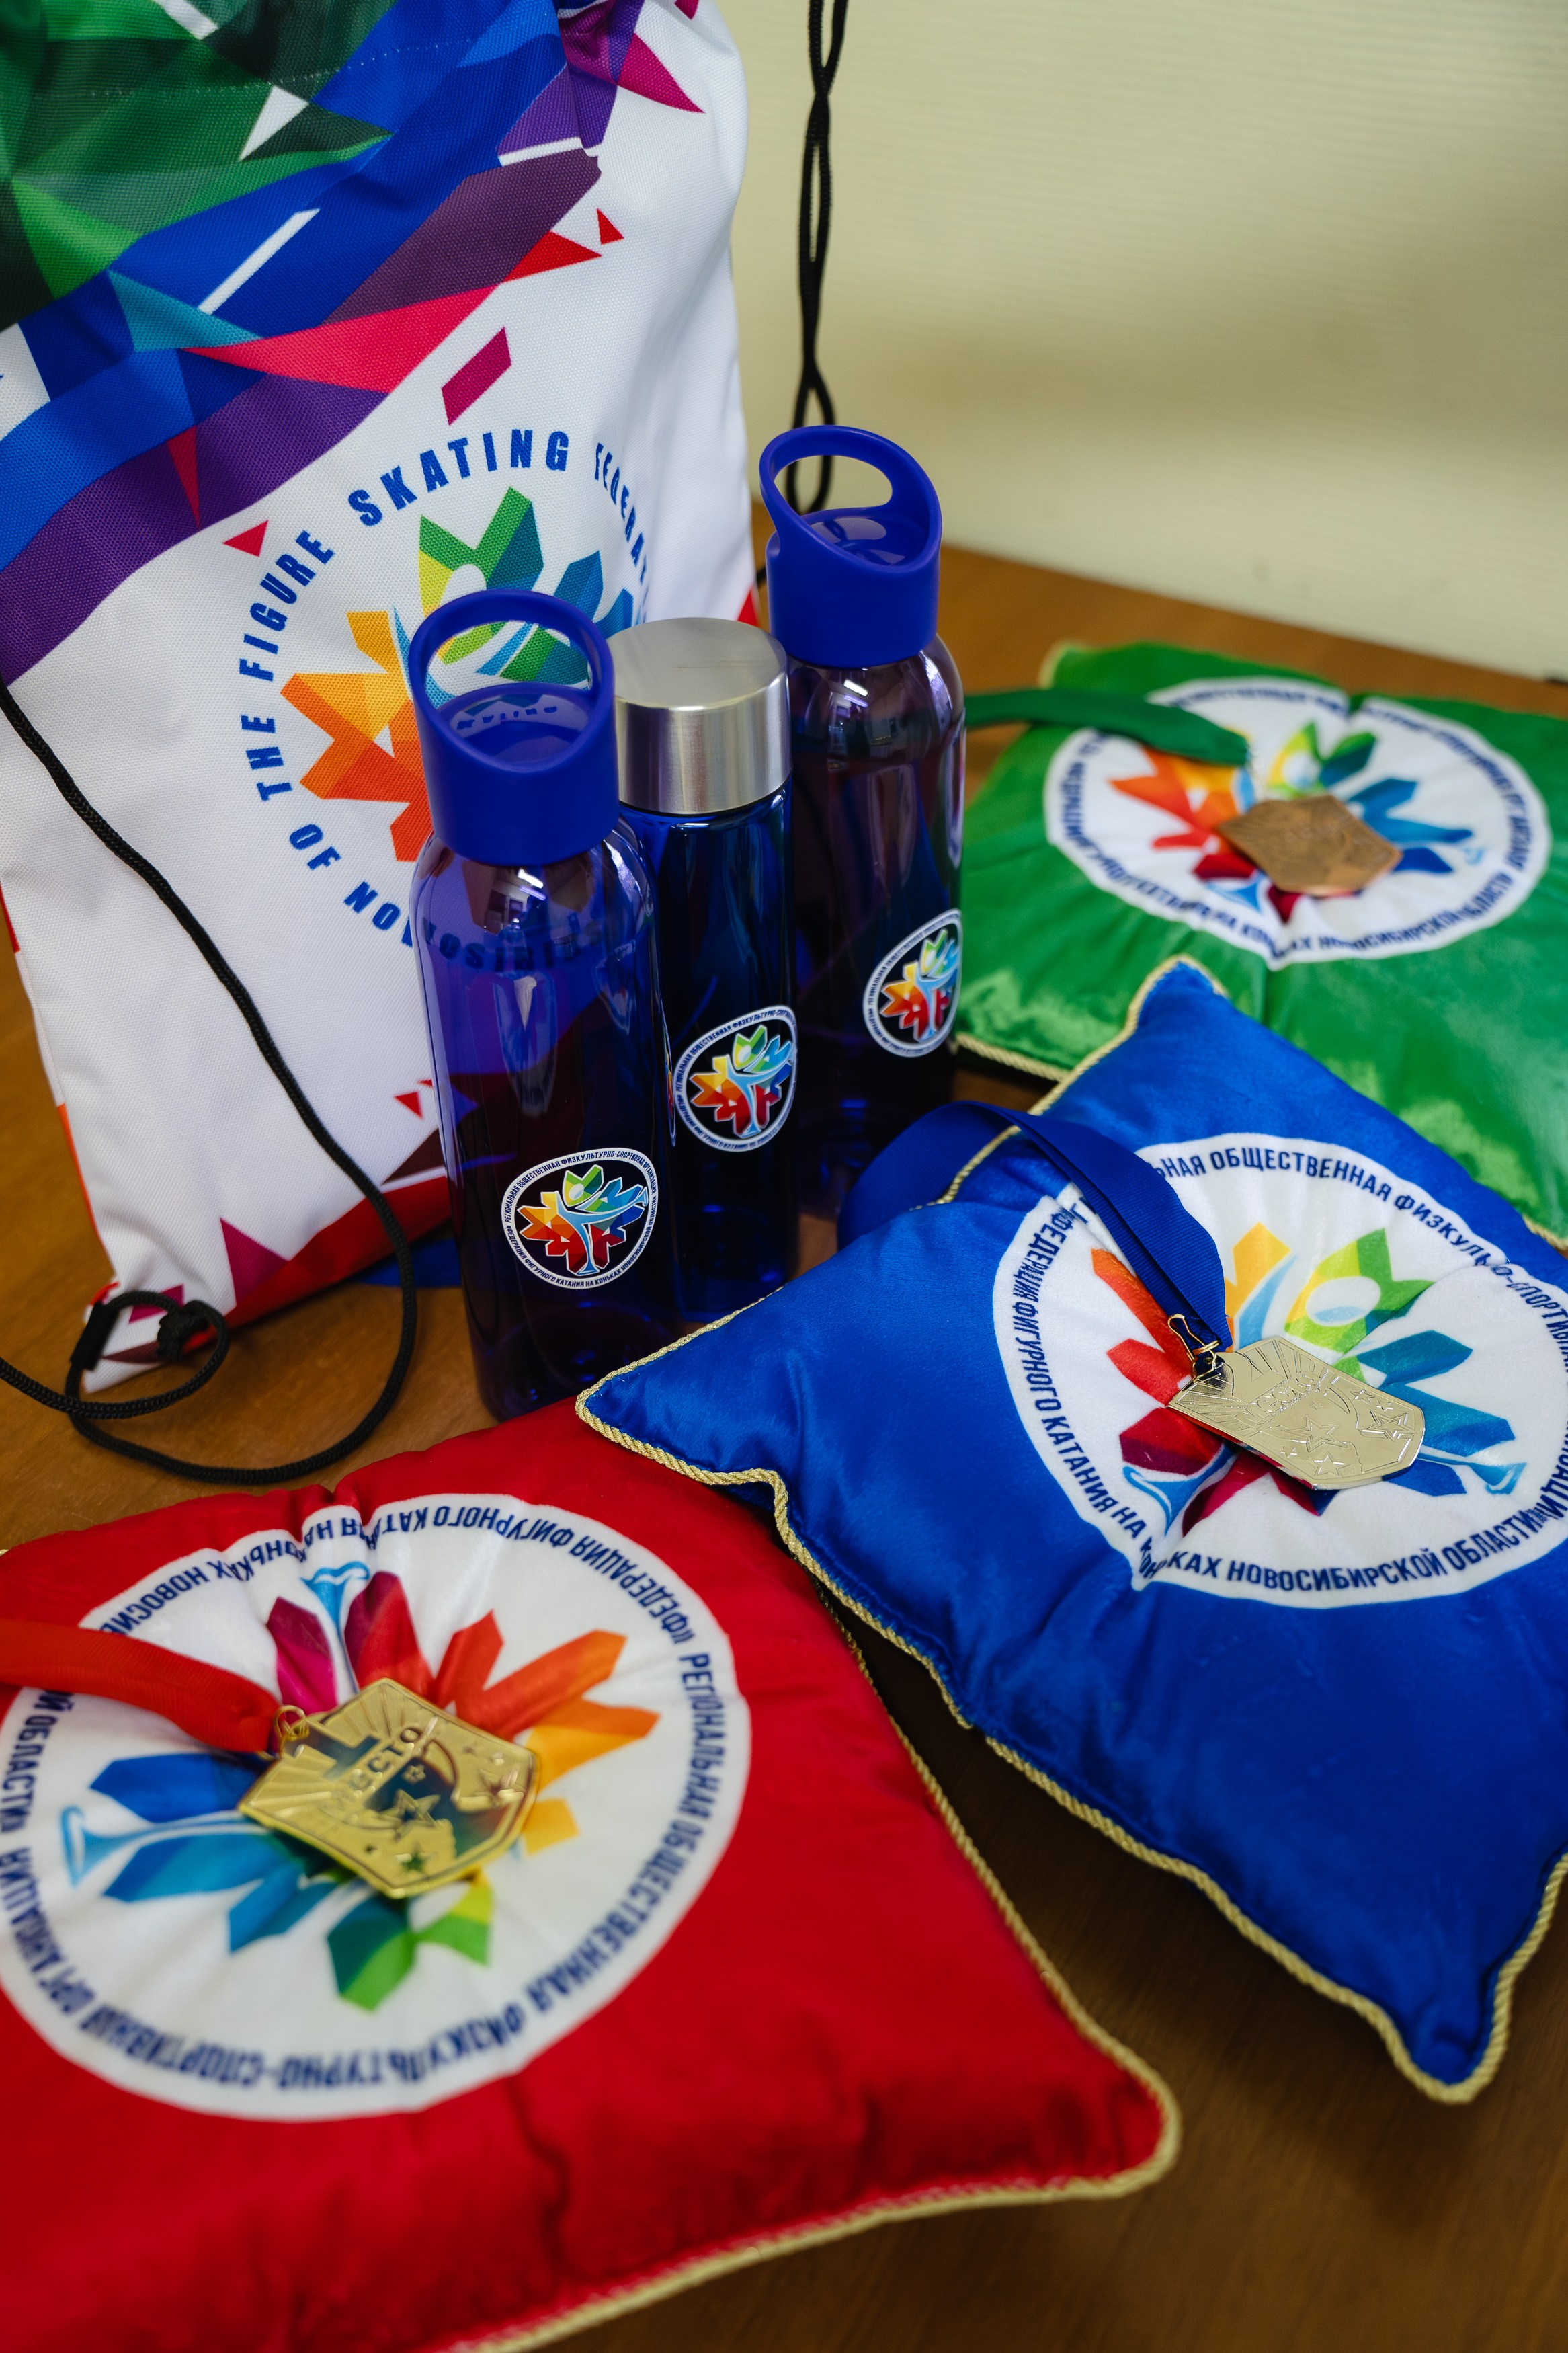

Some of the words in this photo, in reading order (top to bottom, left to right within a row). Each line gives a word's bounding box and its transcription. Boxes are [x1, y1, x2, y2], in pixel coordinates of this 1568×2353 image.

[347, 428, 570, 527] SKATING
[239, 530, 335, 682] FIGURE
[241, 714, 293, 801] THE
[288, 823, 343, 871] OF
[504, 1183, 521, 1224] РЕГИОНАЛЬНАЯ
[516, 1160, 561, 1189] ОБЩЕСТВЕННАЯ
[561, 1150, 645, 1166] ФИЗКУЛЬТУРНО-СПОРТИВНАЯ
[1210, 1146, 1392, 1203] ОБЩЕСТВЕННАЯ
[524, 1259, 556, 1283] ФИГУРНОГО
[556, 1278, 585, 1287] КАТАНИЯ
[595, 1268, 622, 1285] КОНЬКАХ
[621, 1224, 652, 1271] НОВОСИБИРСКОЙ
[1012, 1301, 1062, 1412] ФИГУРНОГО
[1041, 1415, 1119, 1513] КАТАНИЯ
[1111, 1506, 1147, 1540] НА
[1227, 1548, 1448, 1591] НОВОСИБИРСКОЙ
[304, 1520, 334, 1548] НА
[434, 1505, 575, 1549] ФИГУРНОГО
[526, 1818, 707, 2018] ОБЩЕСТВЕННАЯ
